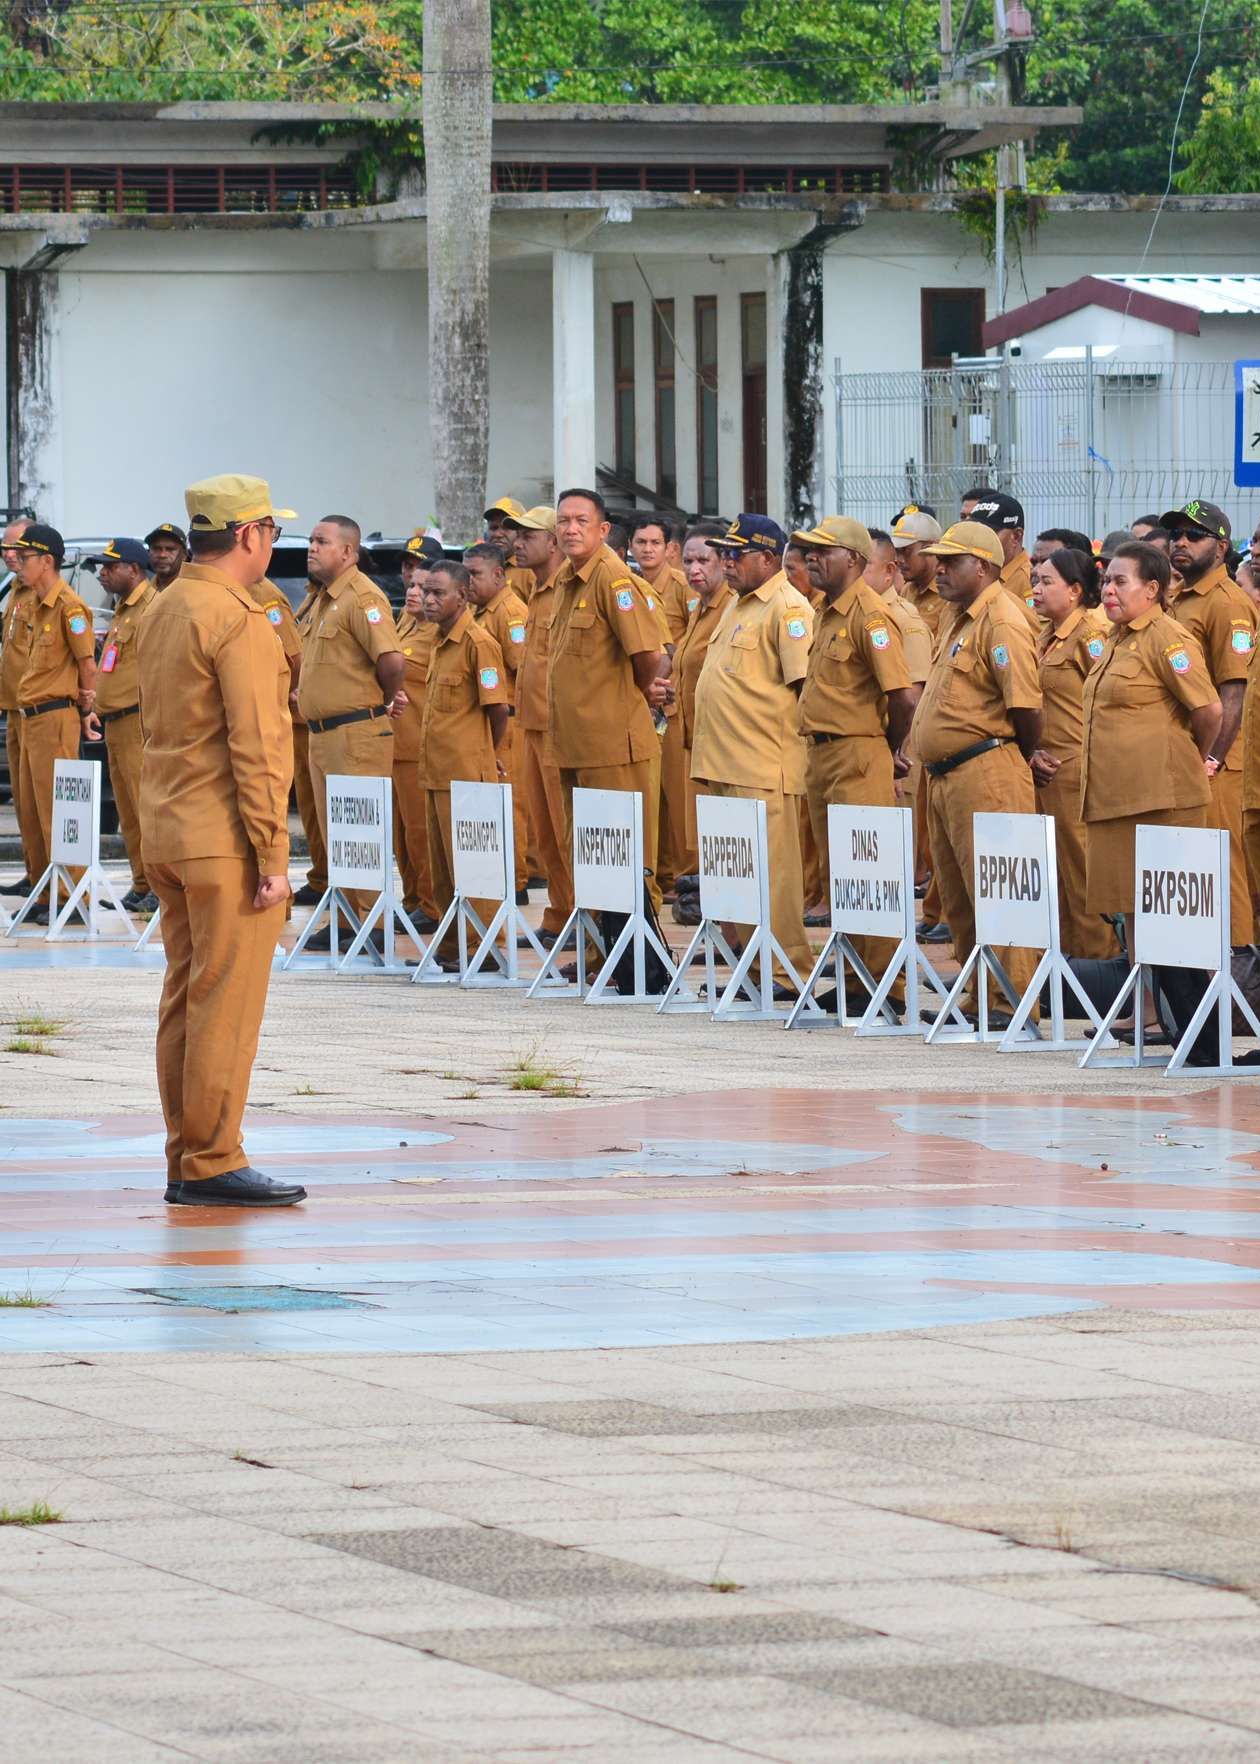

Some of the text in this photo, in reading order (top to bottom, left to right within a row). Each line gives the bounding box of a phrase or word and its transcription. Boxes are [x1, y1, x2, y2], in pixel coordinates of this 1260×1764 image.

[456, 820, 499, 851] KESBANGPOL
[577, 827, 631, 866] INSPEKTORAT
[852, 829, 878, 862] DINAS
[702, 836, 754, 878] BAPPERIDA
[834, 878, 900, 912] DUKCAPIL & PMK
[979, 855, 1041, 901] BPPKAD
[1142, 869, 1214, 918] BKPSDM
